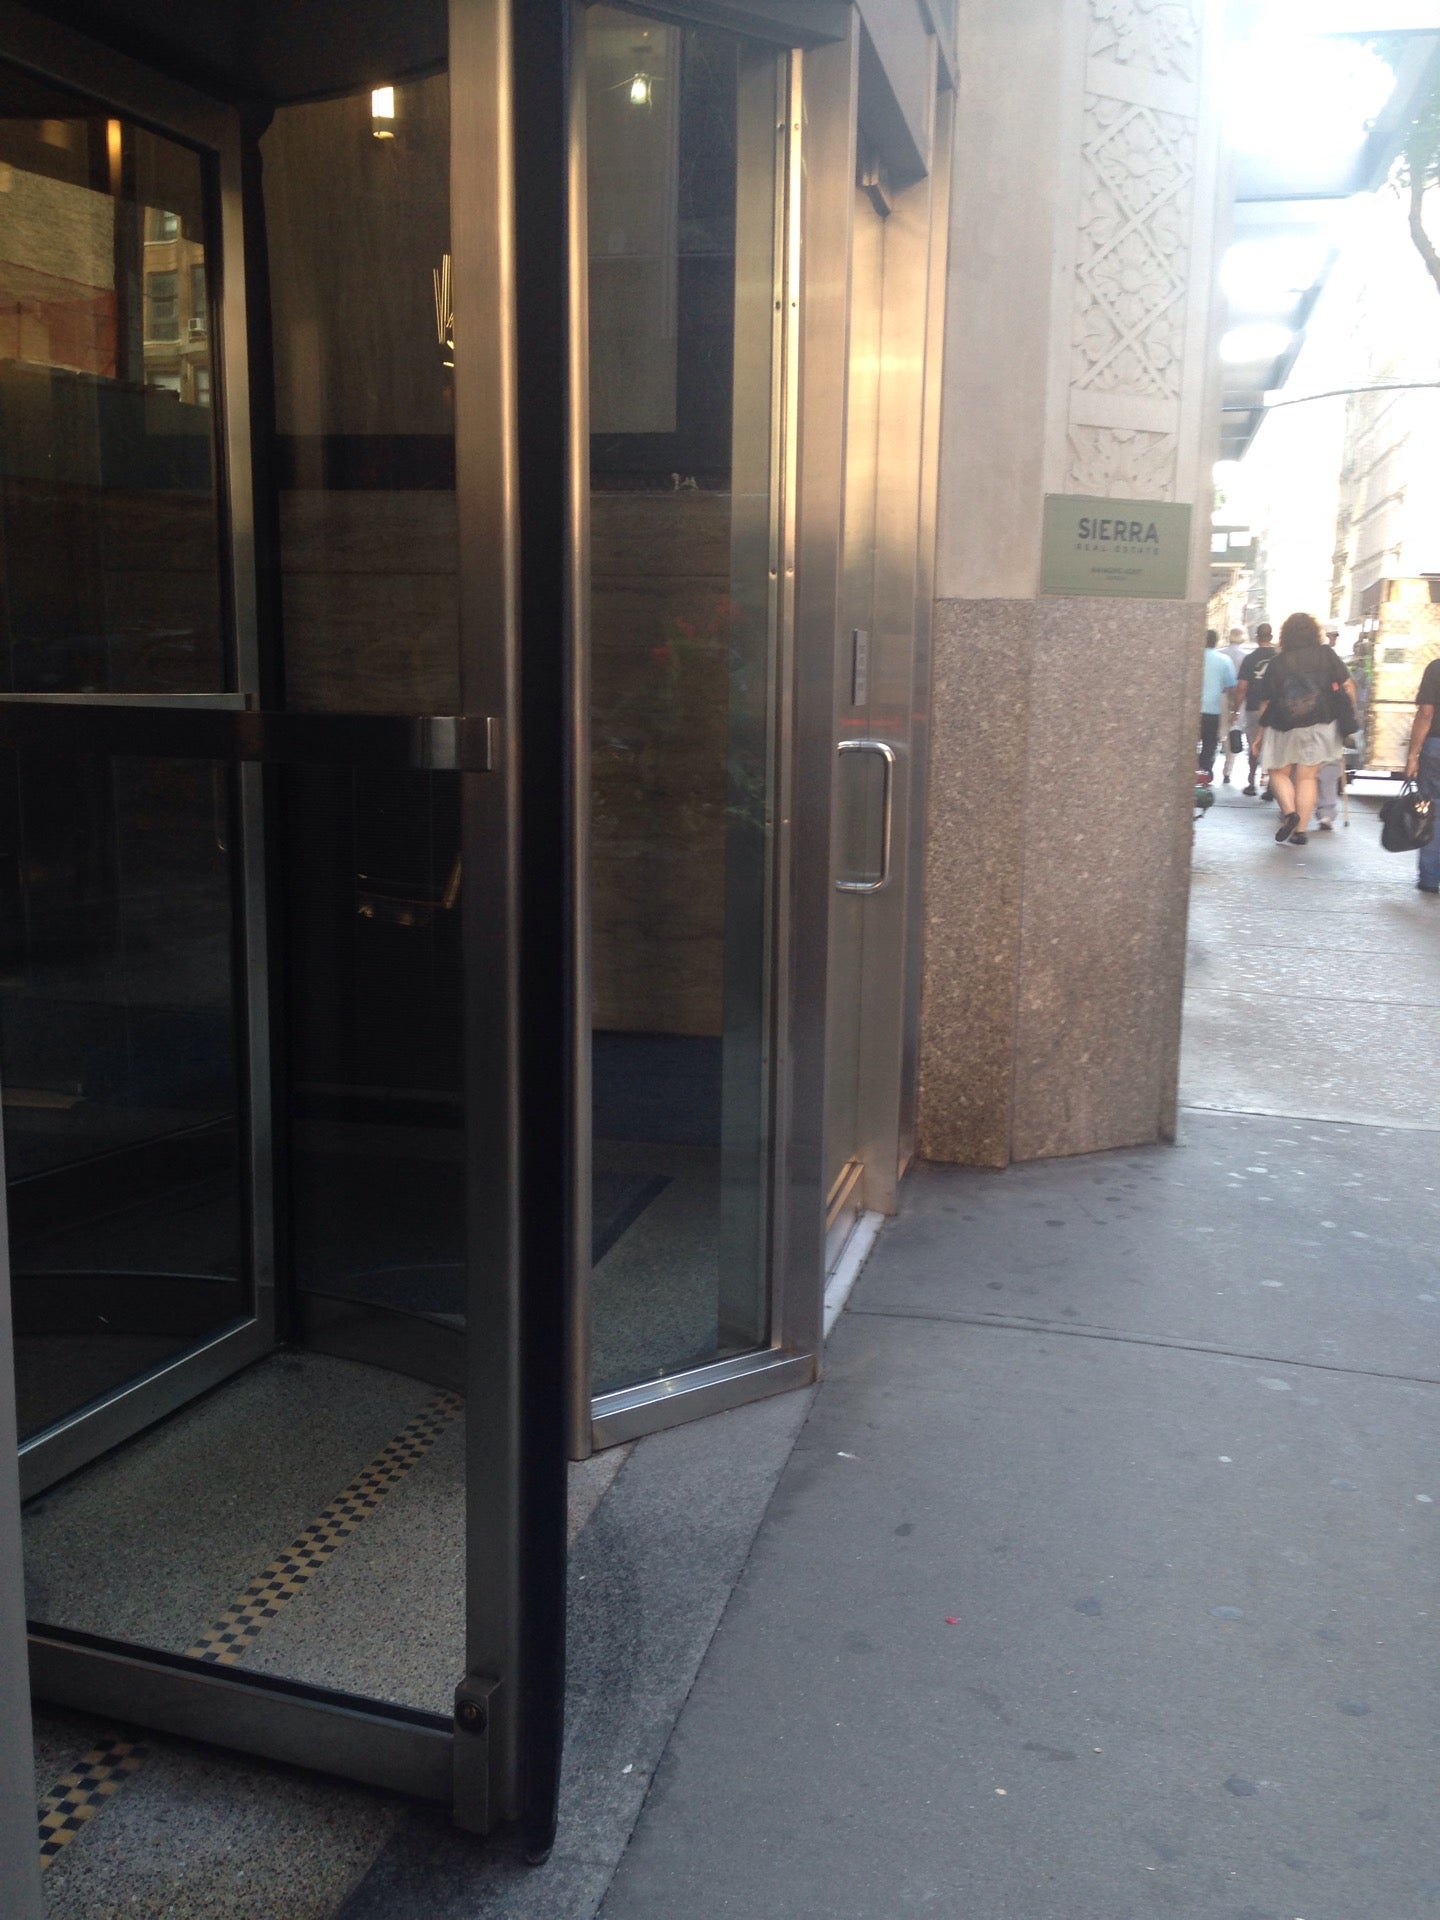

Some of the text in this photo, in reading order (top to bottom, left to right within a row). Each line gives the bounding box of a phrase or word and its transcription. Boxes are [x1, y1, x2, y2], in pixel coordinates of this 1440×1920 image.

[1078, 517, 1160, 543] SIERRA
[1075, 542, 1160, 555] REAL ESTATE
